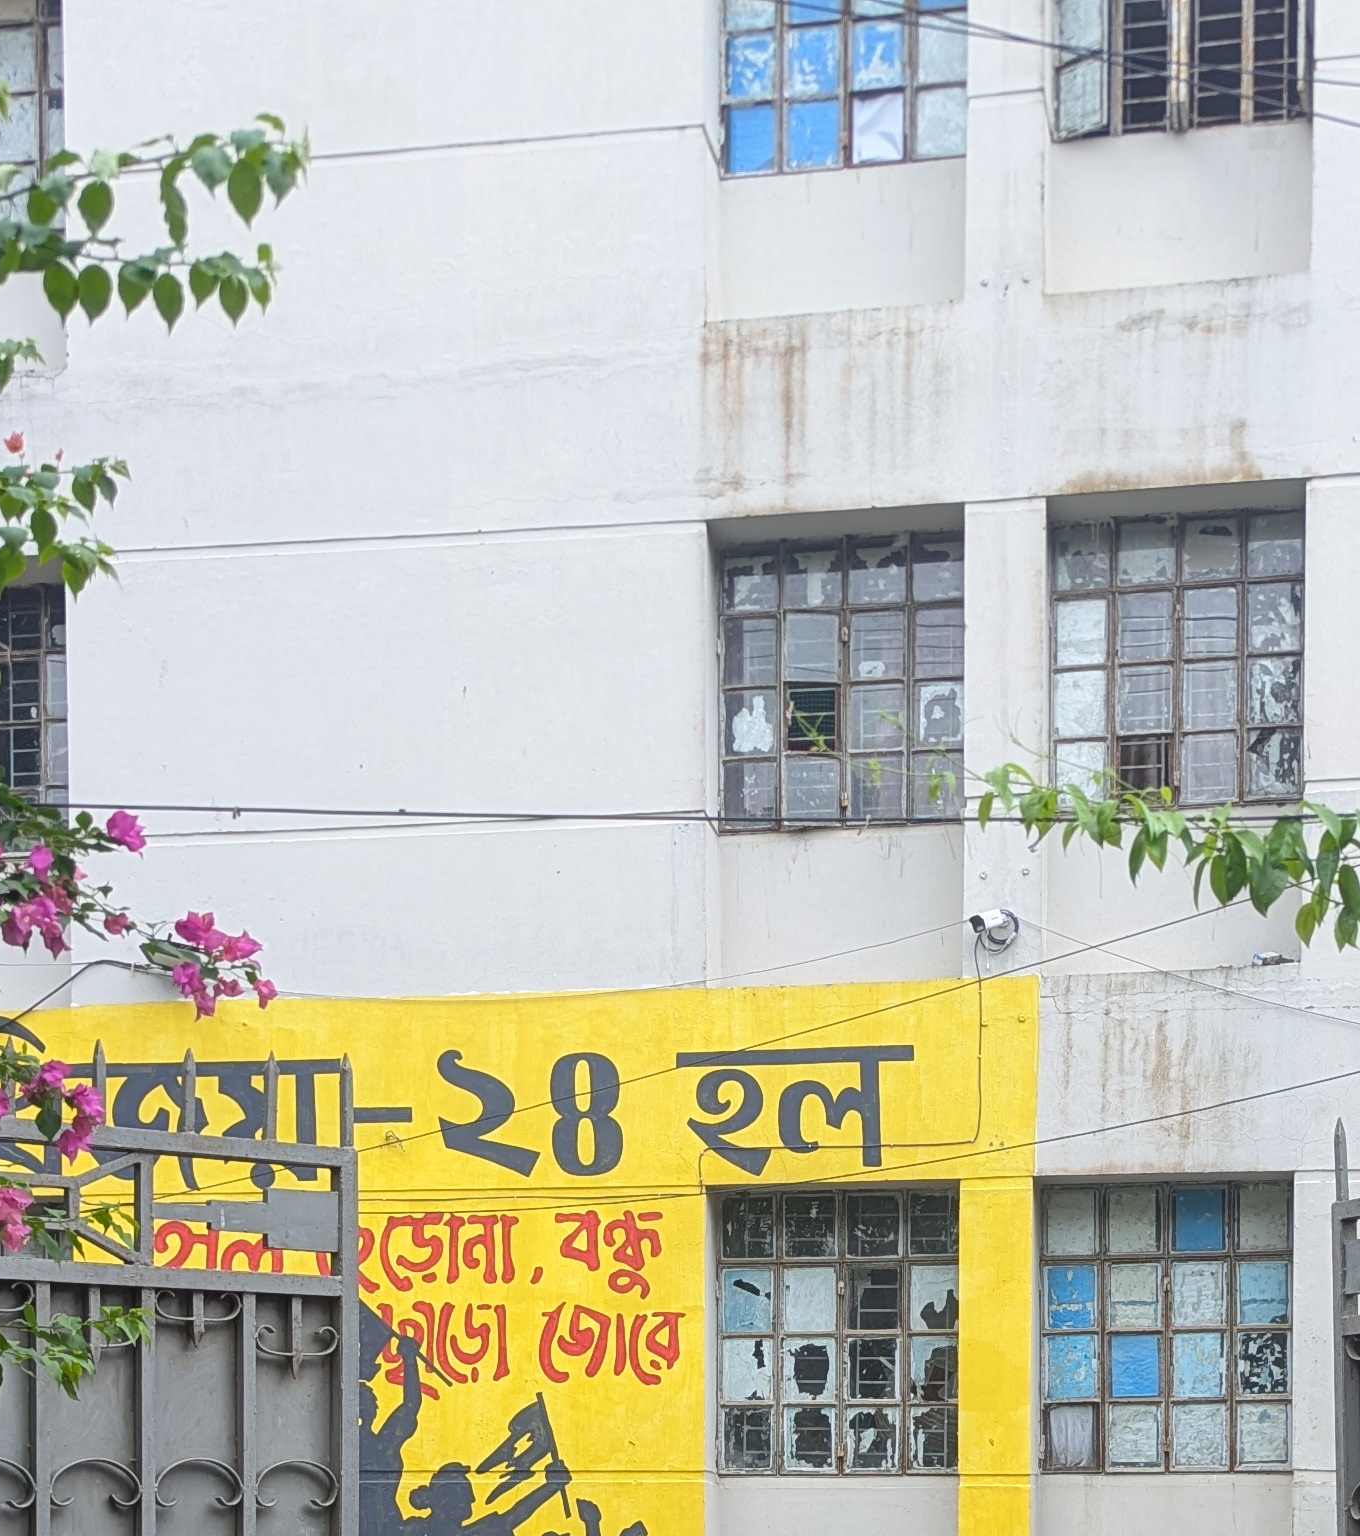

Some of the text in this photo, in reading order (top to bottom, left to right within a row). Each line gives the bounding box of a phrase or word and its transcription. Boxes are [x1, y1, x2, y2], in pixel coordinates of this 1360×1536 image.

[676, 1045, 914, 1177] হল
[554, 1209, 664, 1300] বন্ধু
[539, 1301, 687, 1386] জোরে
